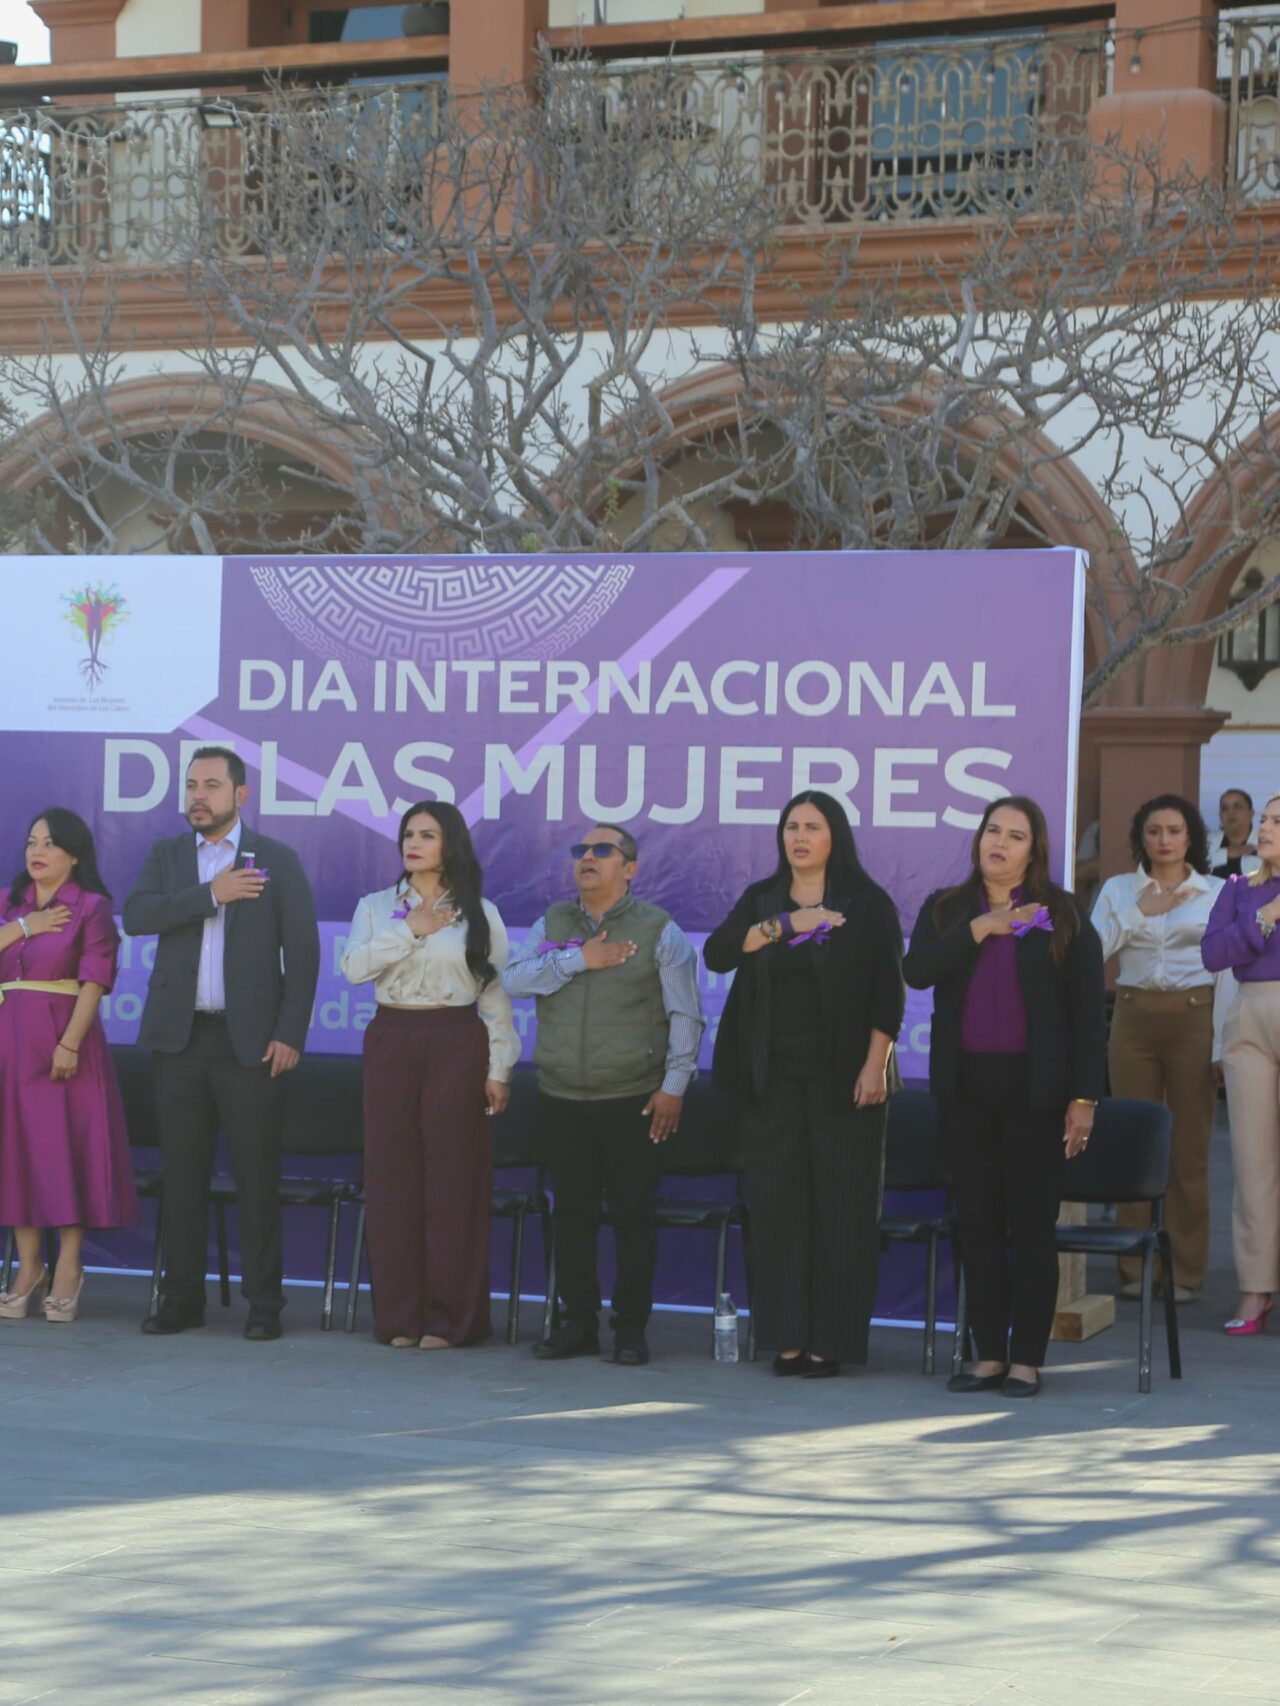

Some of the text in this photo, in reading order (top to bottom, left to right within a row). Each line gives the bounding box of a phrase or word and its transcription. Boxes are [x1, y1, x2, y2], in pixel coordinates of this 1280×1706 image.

[238, 659, 1016, 717] DIA INTERNACIONAL
[259, 741, 456, 817] LAS
[482, 743, 1014, 829] MUJERES
